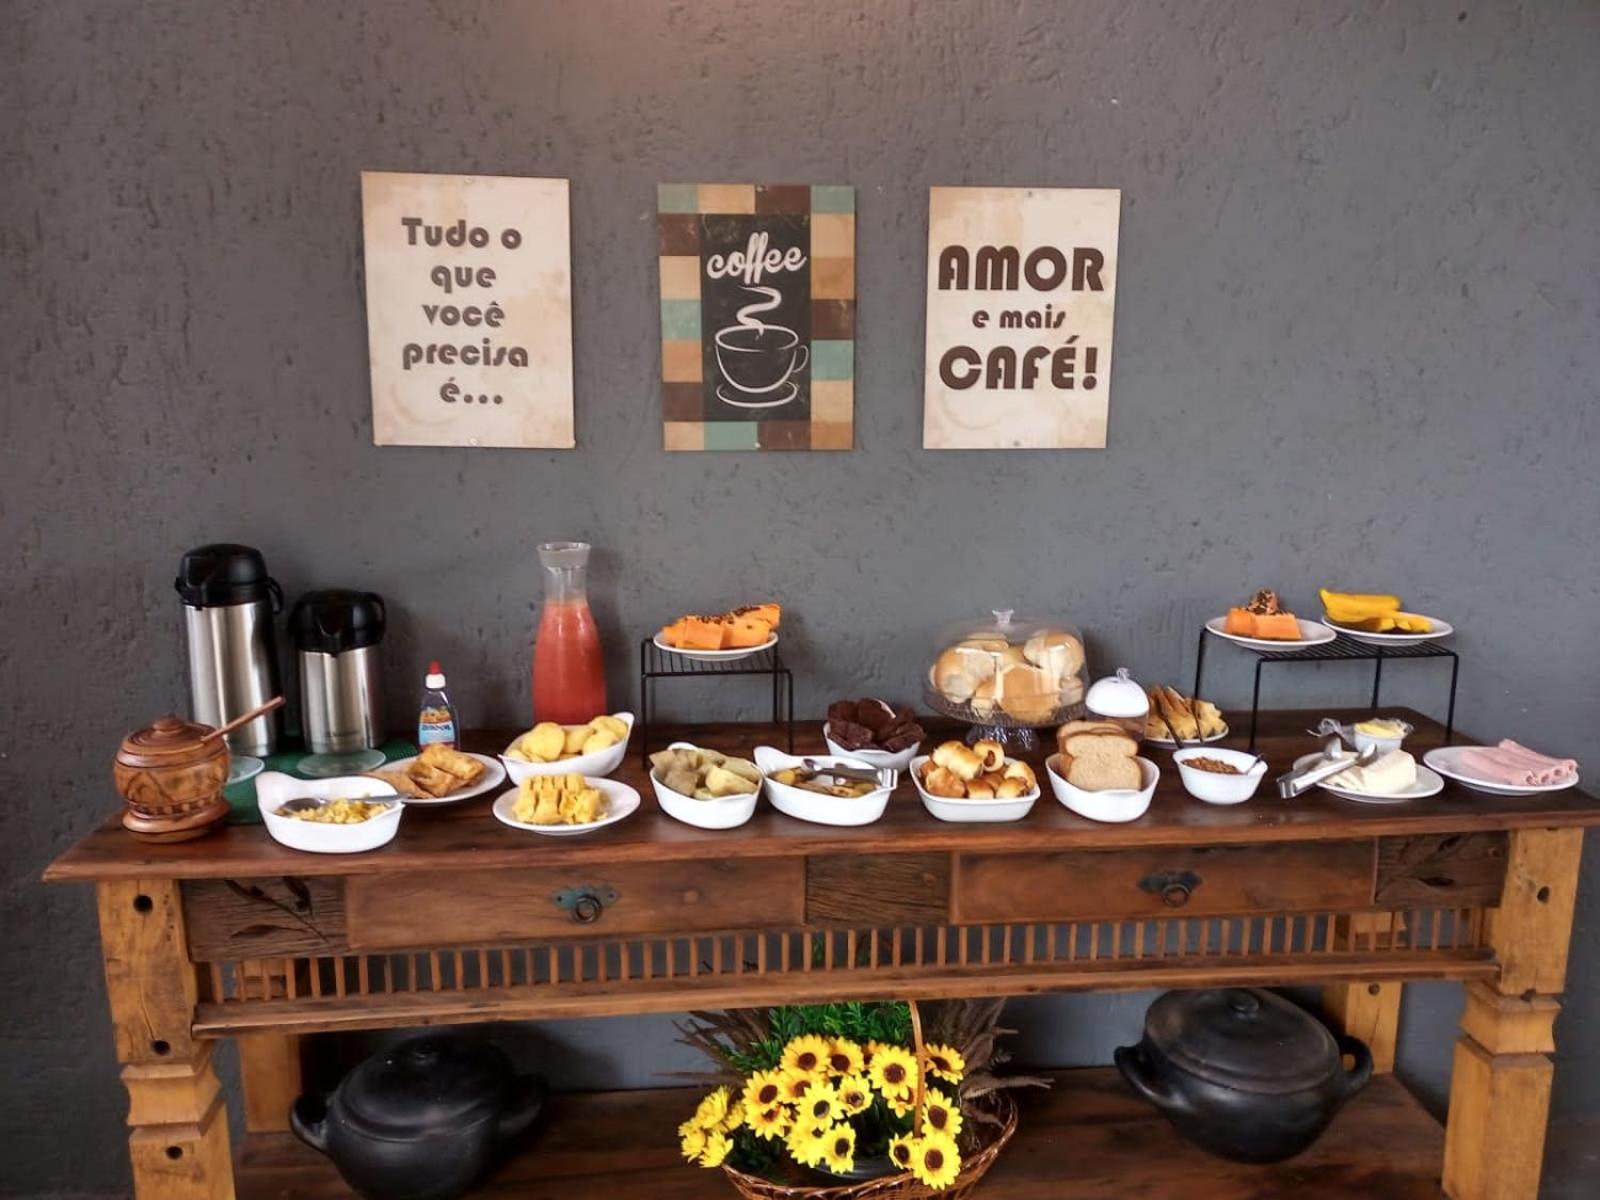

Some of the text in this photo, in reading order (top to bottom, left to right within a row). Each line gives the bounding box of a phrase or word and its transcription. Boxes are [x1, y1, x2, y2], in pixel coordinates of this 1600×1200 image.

[401, 216, 522, 250] Tudo o
[706, 231, 808, 285] coffee
[938, 244, 1105, 292] AMOR
[430, 264, 497, 293] que
[421, 301, 505, 328] você
[972, 303, 1066, 329] e mais
[402, 337, 529, 370] precisa
[938, 335, 1098, 391] CAFÉ!
